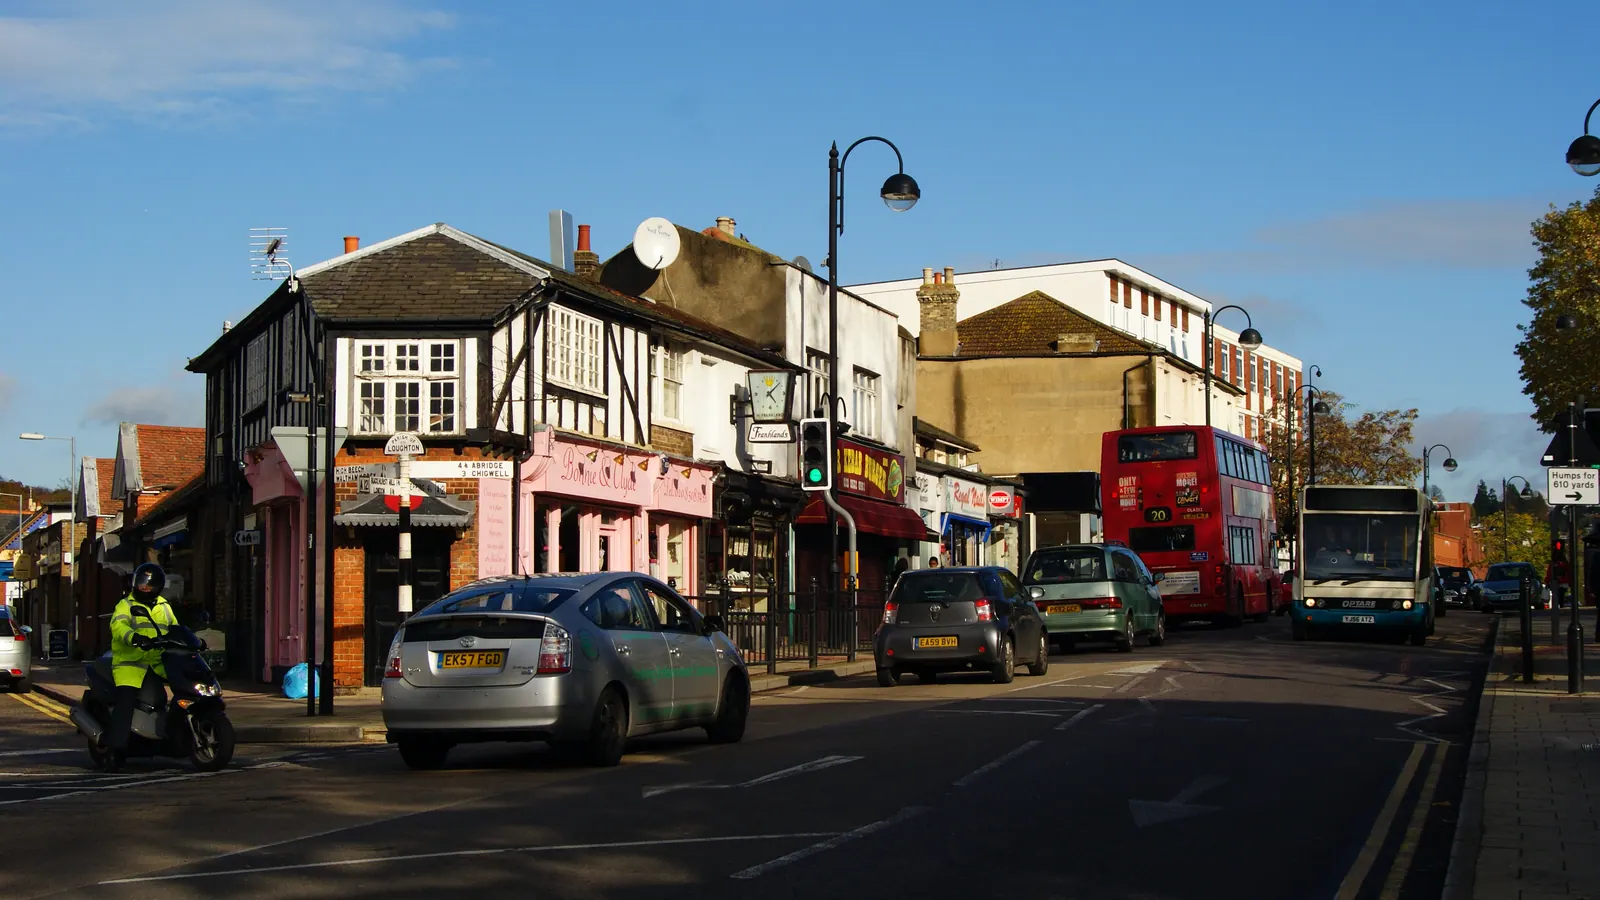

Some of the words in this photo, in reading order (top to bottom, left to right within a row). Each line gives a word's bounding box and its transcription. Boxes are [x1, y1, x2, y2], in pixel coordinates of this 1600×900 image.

[392, 435, 408, 444] PARISH
[561, 447, 596, 484] Bonnie
[599, 457, 611, 487] &
[1552, 471, 1581, 481] Humps
[1583, 471, 1595, 479] for
[1119, 476, 1136, 487] ONLY
[1571, 481, 1595, 490] yards
[1151, 510, 1166, 521] 20
[1342, 600, 1376, 608] OPTARE
[920, 639, 940, 647] EA59
[445, 654, 474, 666] EK57
[477, 653, 500, 665] FGD
